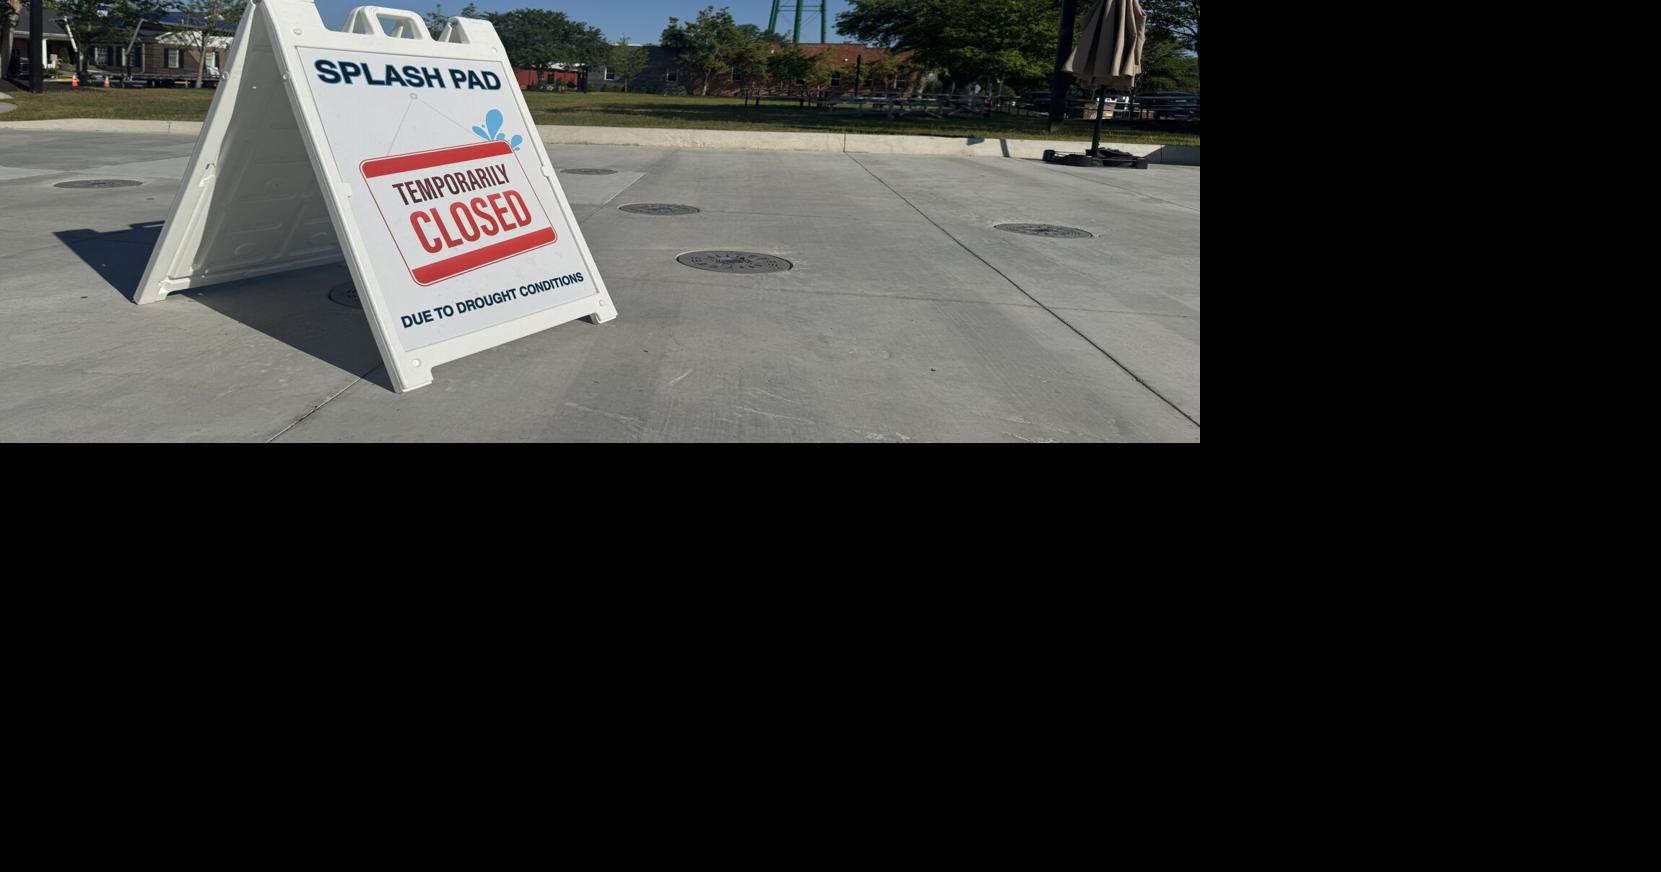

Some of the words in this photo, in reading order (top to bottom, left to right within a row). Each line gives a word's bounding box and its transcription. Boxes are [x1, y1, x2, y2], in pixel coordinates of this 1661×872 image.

[314, 59, 446, 88] SPLASH
[449, 69, 501, 90] PAD
[392, 163, 510, 206] TEMPORARILY
[409, 190, 532, 254] CLOSED
[401, 310, 434, 328] DUE
[434, 305, 454, 320] TO
[456, 288, 518, 314] DROUGHT
[519, 272, 584, 297] CONDITIONS
